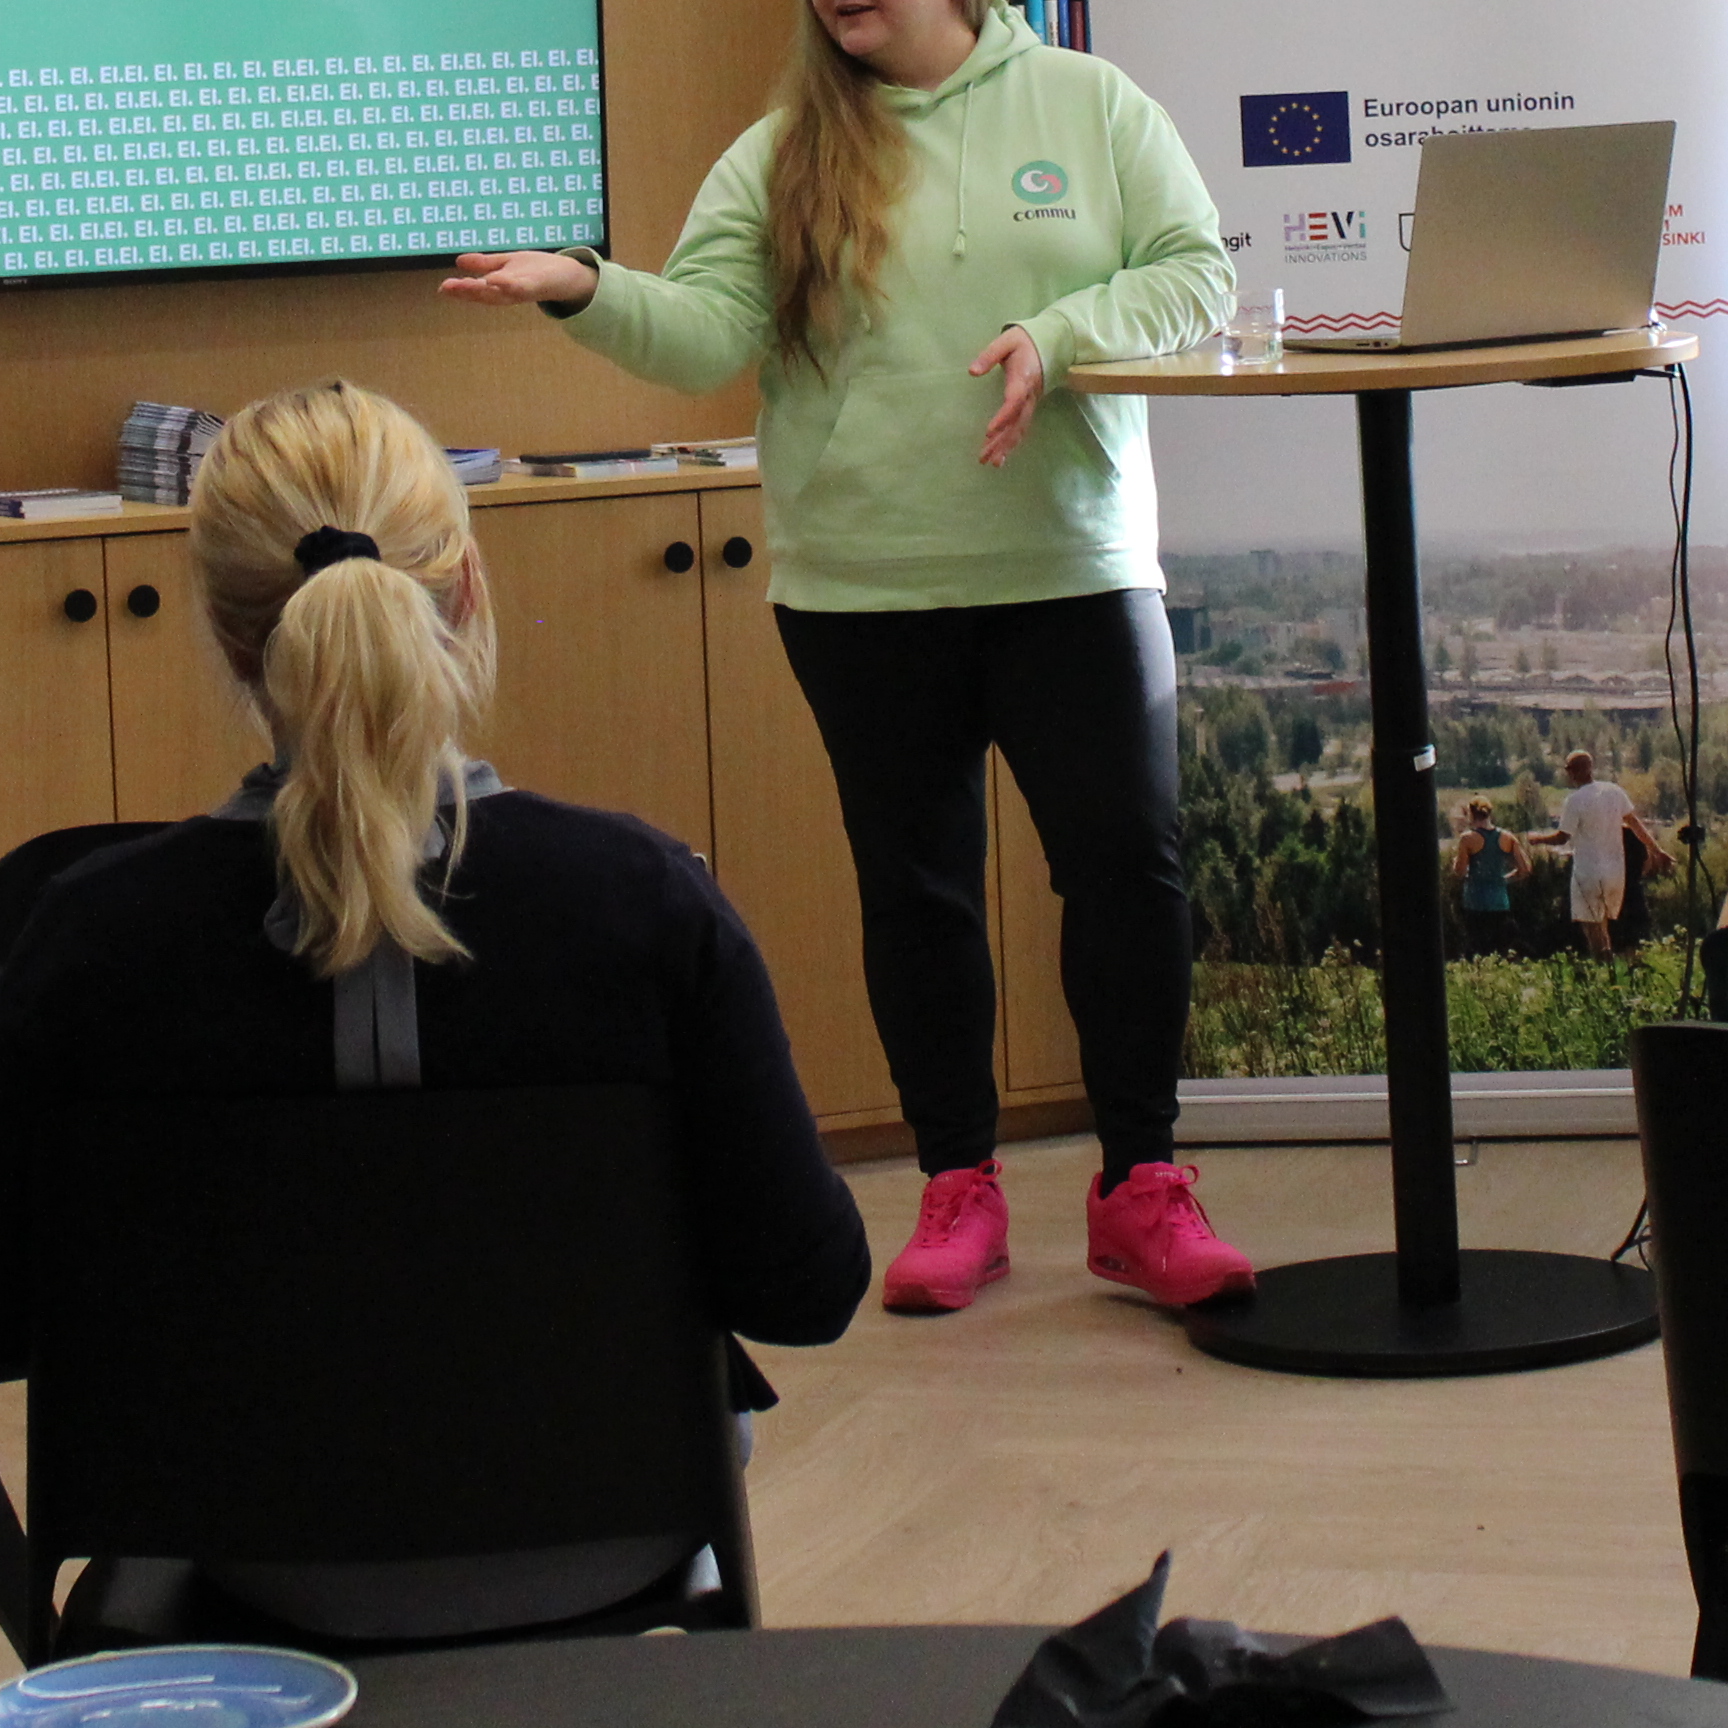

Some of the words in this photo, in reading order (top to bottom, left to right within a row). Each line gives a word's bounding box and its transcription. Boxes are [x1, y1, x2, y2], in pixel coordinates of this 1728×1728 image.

[9, 69, 33, 87] EI.
[40, 68, 64, 86] EI.
[70, 67, 94, 84] EI.
[154, 64, 178, 81] EI.
[184, 63, 208, 80] EI.
[213, 62, 237, 79] EI.
[243, 61, 266, 78] EI.
[326, 58, 349, 75] EI.
[354, 57, 377, 74] EI.
[383, 56, 406, 72] EI.
[412, 54, 434, 72] EI.
[492, 52, 515, 68] EI.
[521, 50, 543, 68] EI.
[548, 50, 571, 66] EI.
[1363, 98, 1478, 119] Euroopan
[1486, 91, 1575, 112] unionin
[1013, 207, 1077, 222] commu
[1284, 251, 1368, 264] INNOVATIONS
